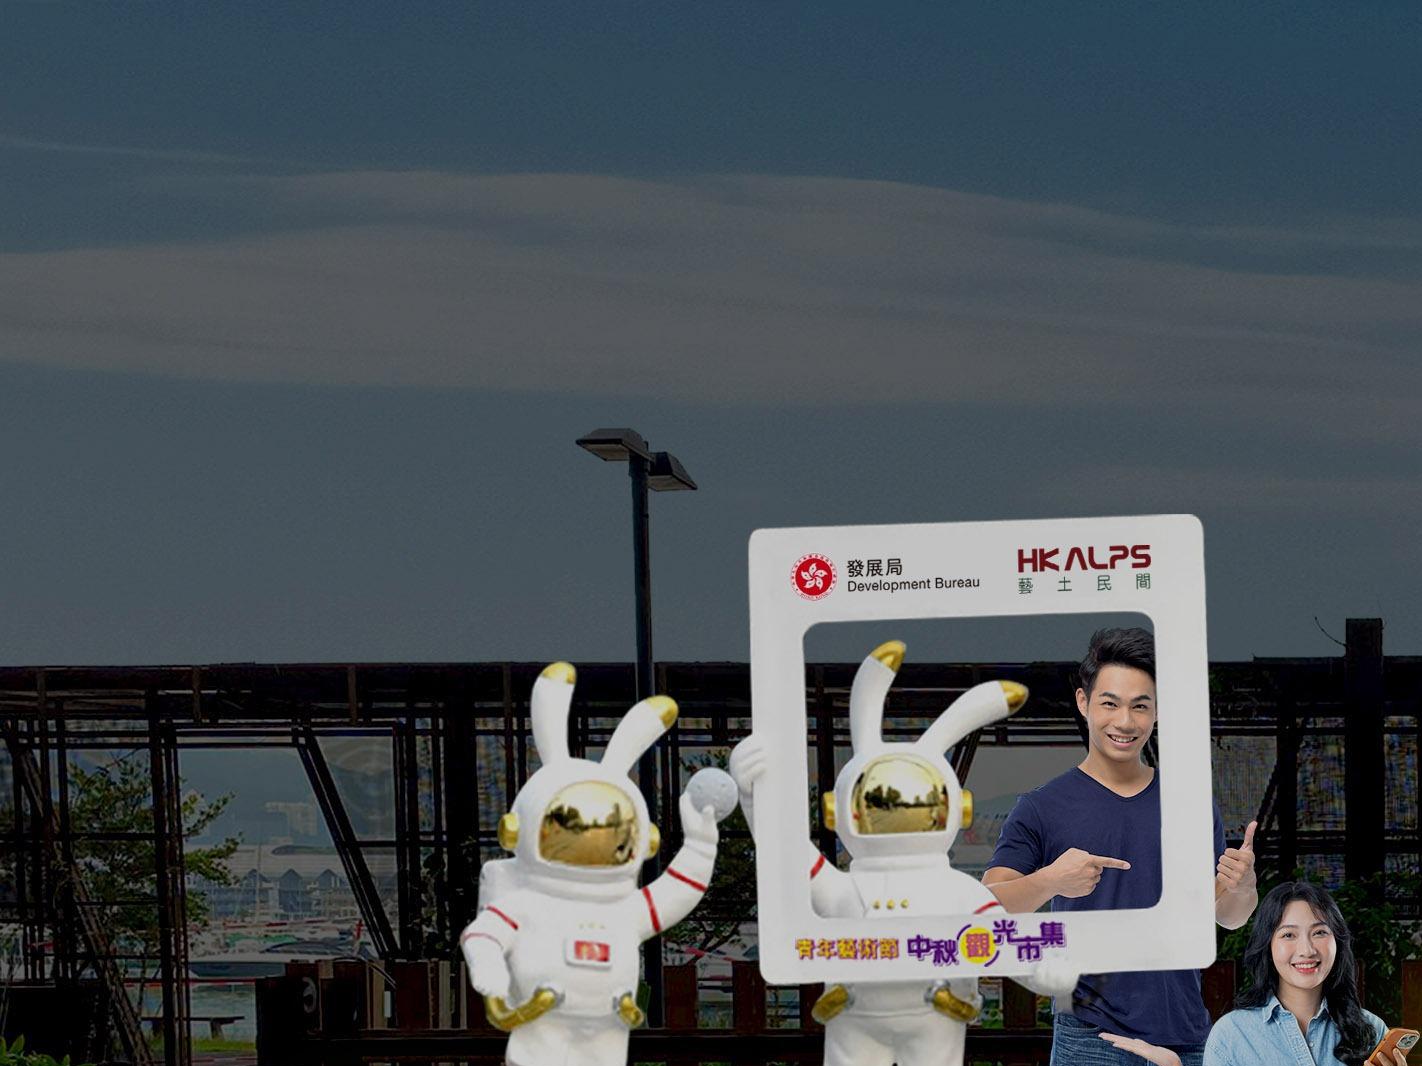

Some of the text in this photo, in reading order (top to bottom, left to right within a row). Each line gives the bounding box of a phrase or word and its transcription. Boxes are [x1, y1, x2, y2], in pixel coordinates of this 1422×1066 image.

[847, 558, 903, 578] 發展局
[847, 577, 981, 593] Development Bureau
[795, 937, 900, 961] 青年藝術節
